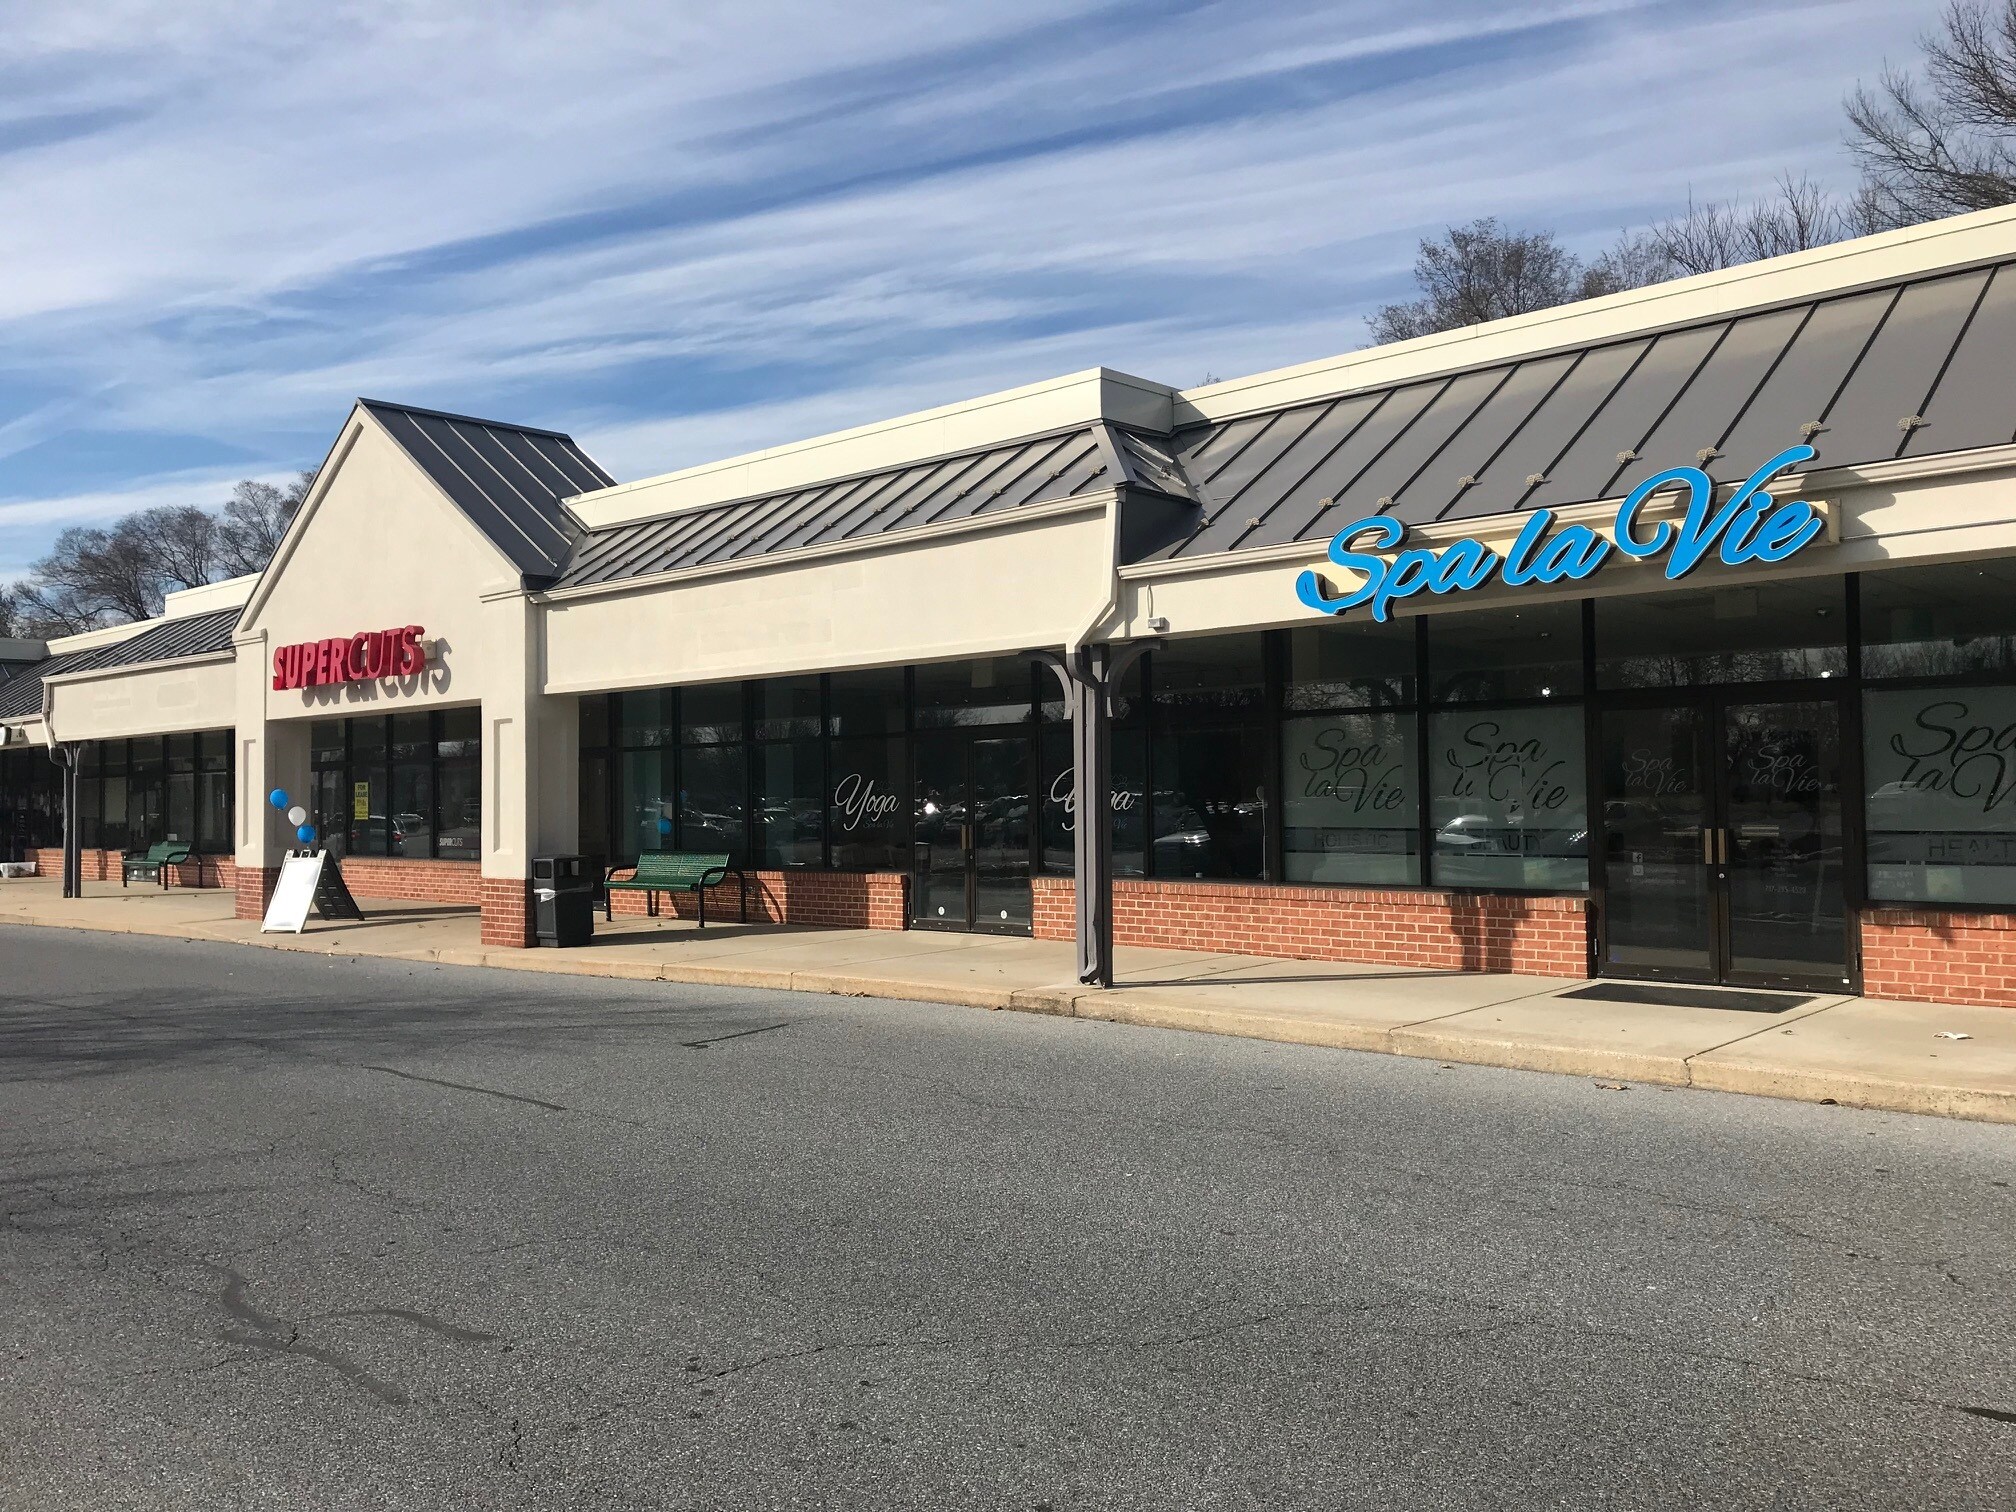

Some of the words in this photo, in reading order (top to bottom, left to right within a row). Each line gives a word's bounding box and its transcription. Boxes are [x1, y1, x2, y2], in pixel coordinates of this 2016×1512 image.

[1296, 515, 1498, 623] Spa
[1502, 509, 1610, 586] la
[1614, 444, 1823, 580] Vie
[273, 625, 425, 691] SUPERCUTS
[1300, 728, 1388, 778] Spa
[1447, 722, 1547, 776] Spa
[1622, 748, 1673, 776] Spa
[1748, 744, 1807, 774] Spa
[835, 773, 901, 831] Yoga
[1051, 766, 1135, 831] Ya
[1305, 771, 1335, 797] la
[1336, 764, 1406, 814] Vie
[1625, 772, 1643, 787] la
[1644, 768, 1688, 797] Vie
[1752, 769, 1773, 785] la
[1772, 765, 1822, 793] Vie
